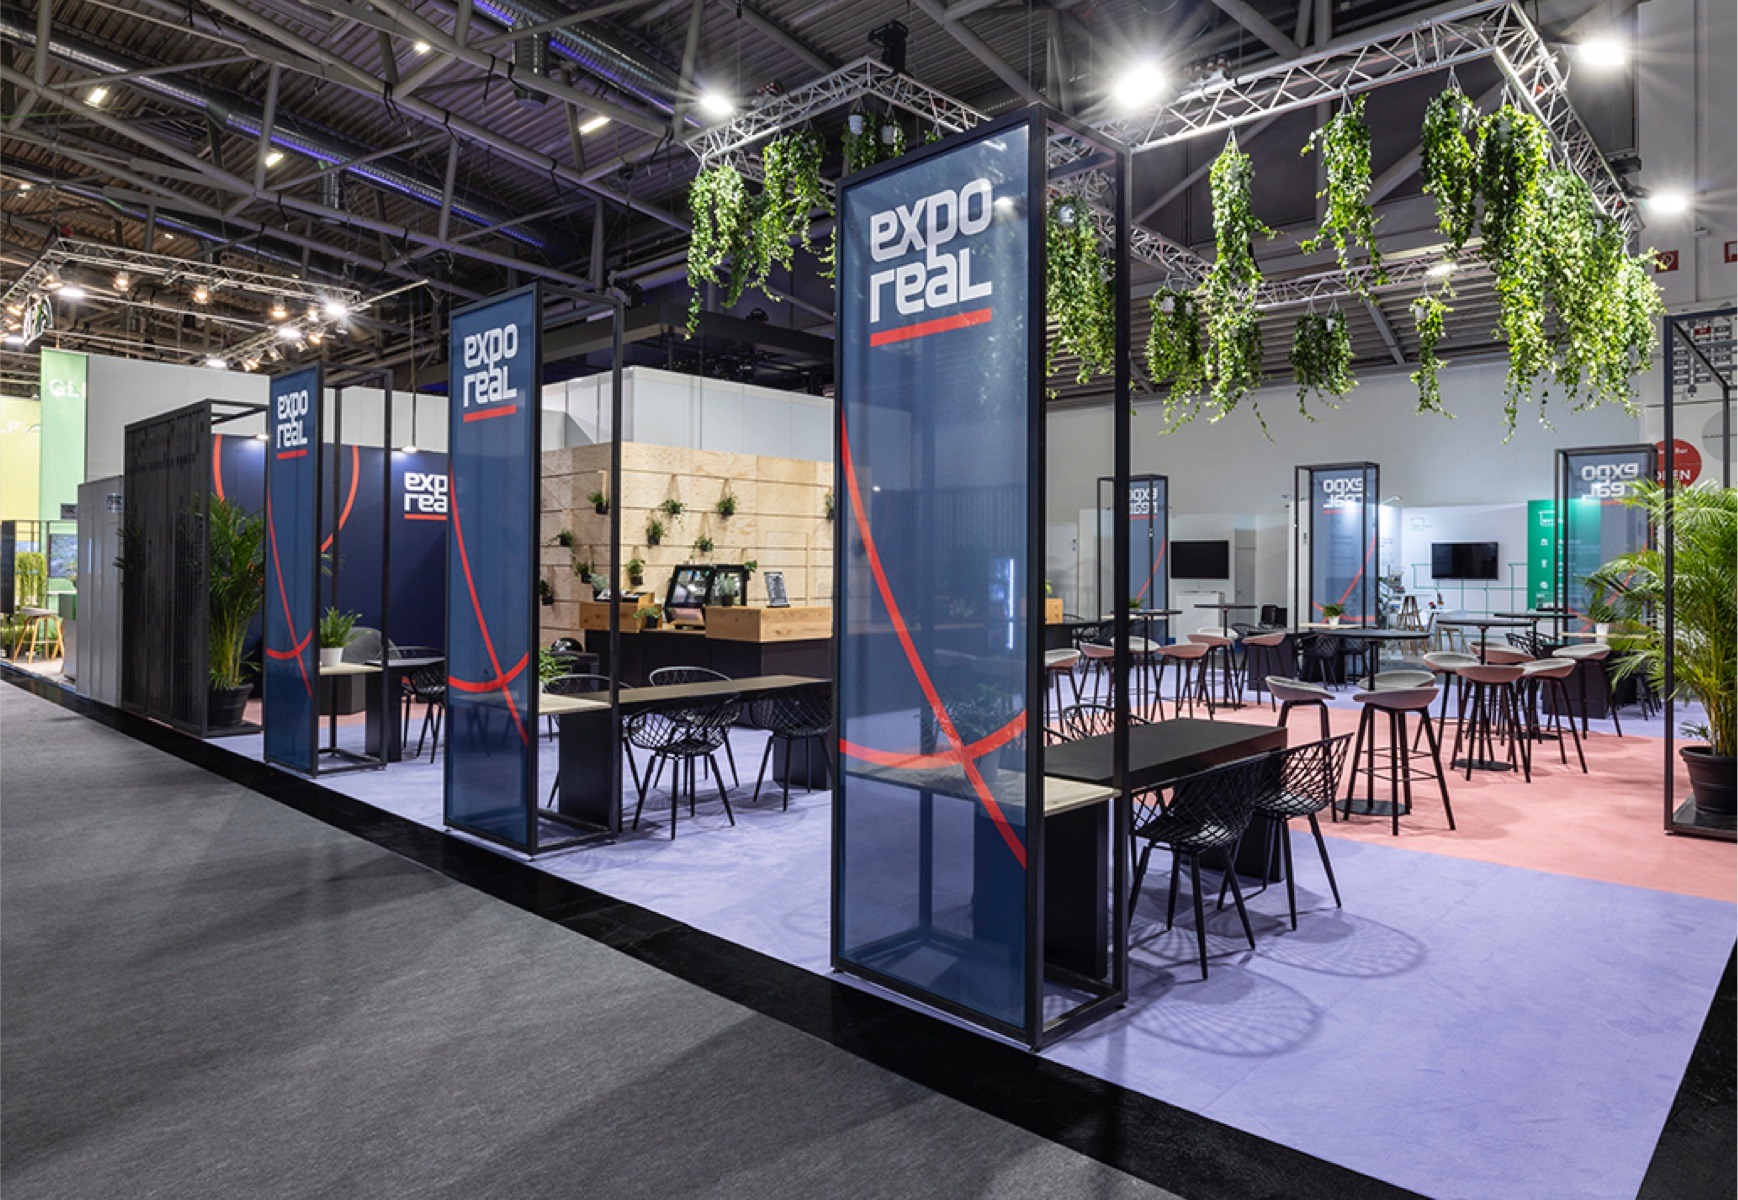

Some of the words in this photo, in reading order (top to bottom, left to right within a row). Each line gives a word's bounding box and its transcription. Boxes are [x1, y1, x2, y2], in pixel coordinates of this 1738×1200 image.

[870, 178, 992, 268] expo
[464, 323, 518, 370] expo
[48, 378, 86, 398] GL
[277, 389, 308, 420] expo
